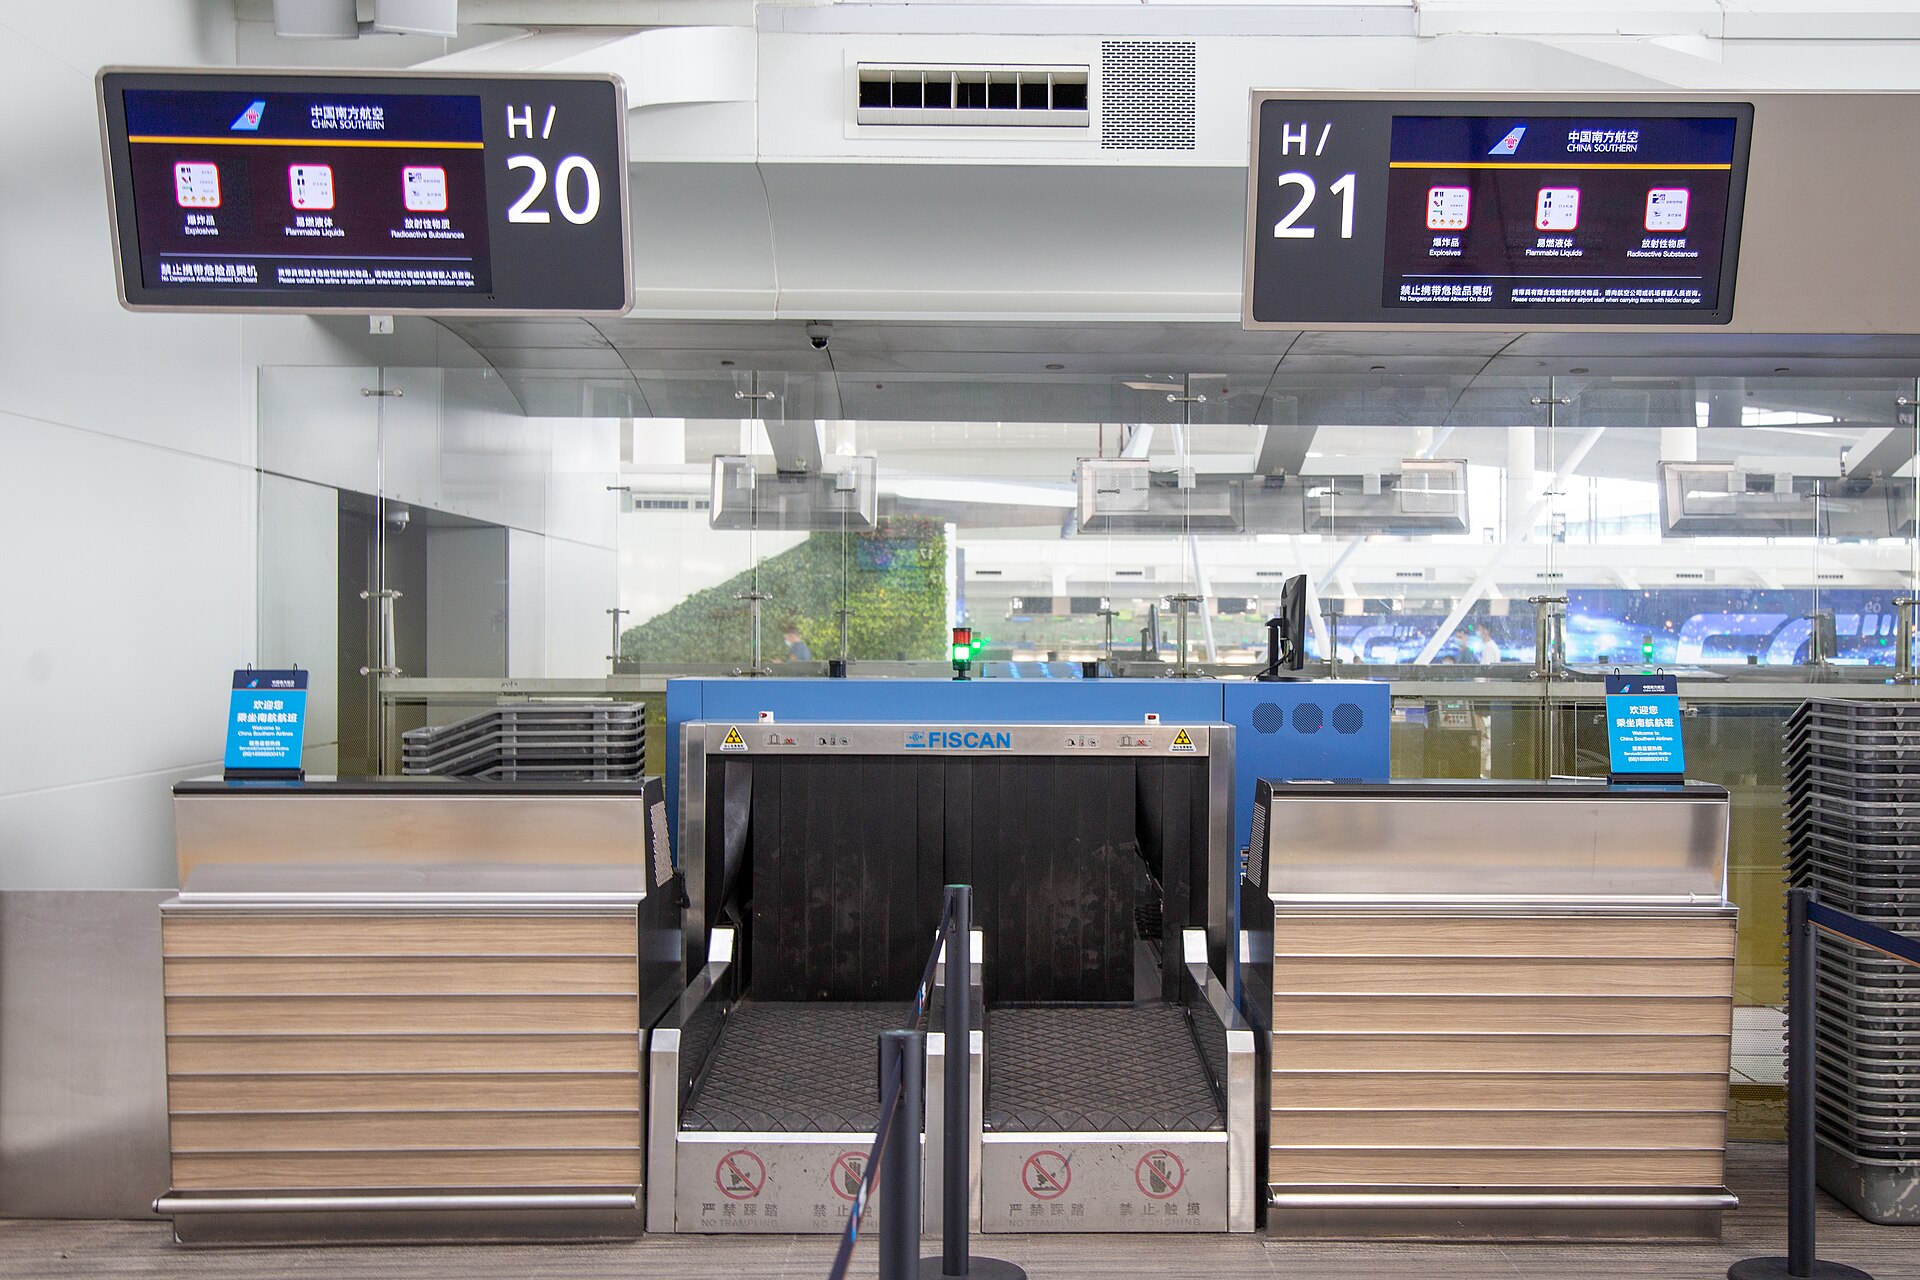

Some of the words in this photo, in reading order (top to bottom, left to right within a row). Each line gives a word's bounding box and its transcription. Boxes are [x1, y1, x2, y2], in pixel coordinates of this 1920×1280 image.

[311, 105, 384, 120] 中国南方航空
[311, 119, 338, 129] CHINA
[339, 120, 385, 130] SOUTHERN
[507, 105, 556, 139] H/
[1282, 123, 1331, 156] H/
[1568, 131, 1639, 143] 中国南方航空
[1567, 144, 1592, 152] CHINA
[1593, 144, 1638, 153] SOUTHERN
[507, 155, 600, 225] 20
[1274, 172, 1356, 239] 21
[187, 214, 215, 226] 爆炸品
[405, 218, 451, 230] 放射性物质
[185, 226, 219, 236] Explosives
[285, 227, 320, 236] Flammable
[321, 228, 346, 237] Liquids
[390, 230, 428, 239] Radioactive
[428, 231, 465, 239] Substances
[1432, 237, 1460, 247] 爆炸品
[1536, 239, 1573, 248] 易燃液体
[1641, 239, 1686, 249] 放射性物质
[1429, 249, 1461, 257] Explosives
[1525, 249, 1559, 257] Flammable
[1559, 249, 1583, 257] Liquids
[1626, 250, 1662, 258] Radioactive
[1662, 250, 1698, 258] Substances
[1400, 285, 1493, 296] 禁止携带危险品乘机
[253, 700, 284, 711] 欢迎您
[1629, 705, 1659, 715] 欢迎您
[237, 712, 298, 723] 乘坐南航航班
[1616, 718, 1674, 728] 乘坐南航航班
[928, 731, 1011, 749] FISCAN
[702, 1203, 778, 1217] 严禁踩踏
[1009, 1203, 1085, 1217] 严禁踩踏
[1119, 1202, 1201, 1216] 禁止触摸
[701, 1219, 717, 1228] NO
[720, 1219, 778, 1228] TRAMPLING
[813, 1220, 829, 1228] NO
[1009, 1219, 1024, 1228] NO
[1027, 1219, 1085, 1228] TRAMPLING
